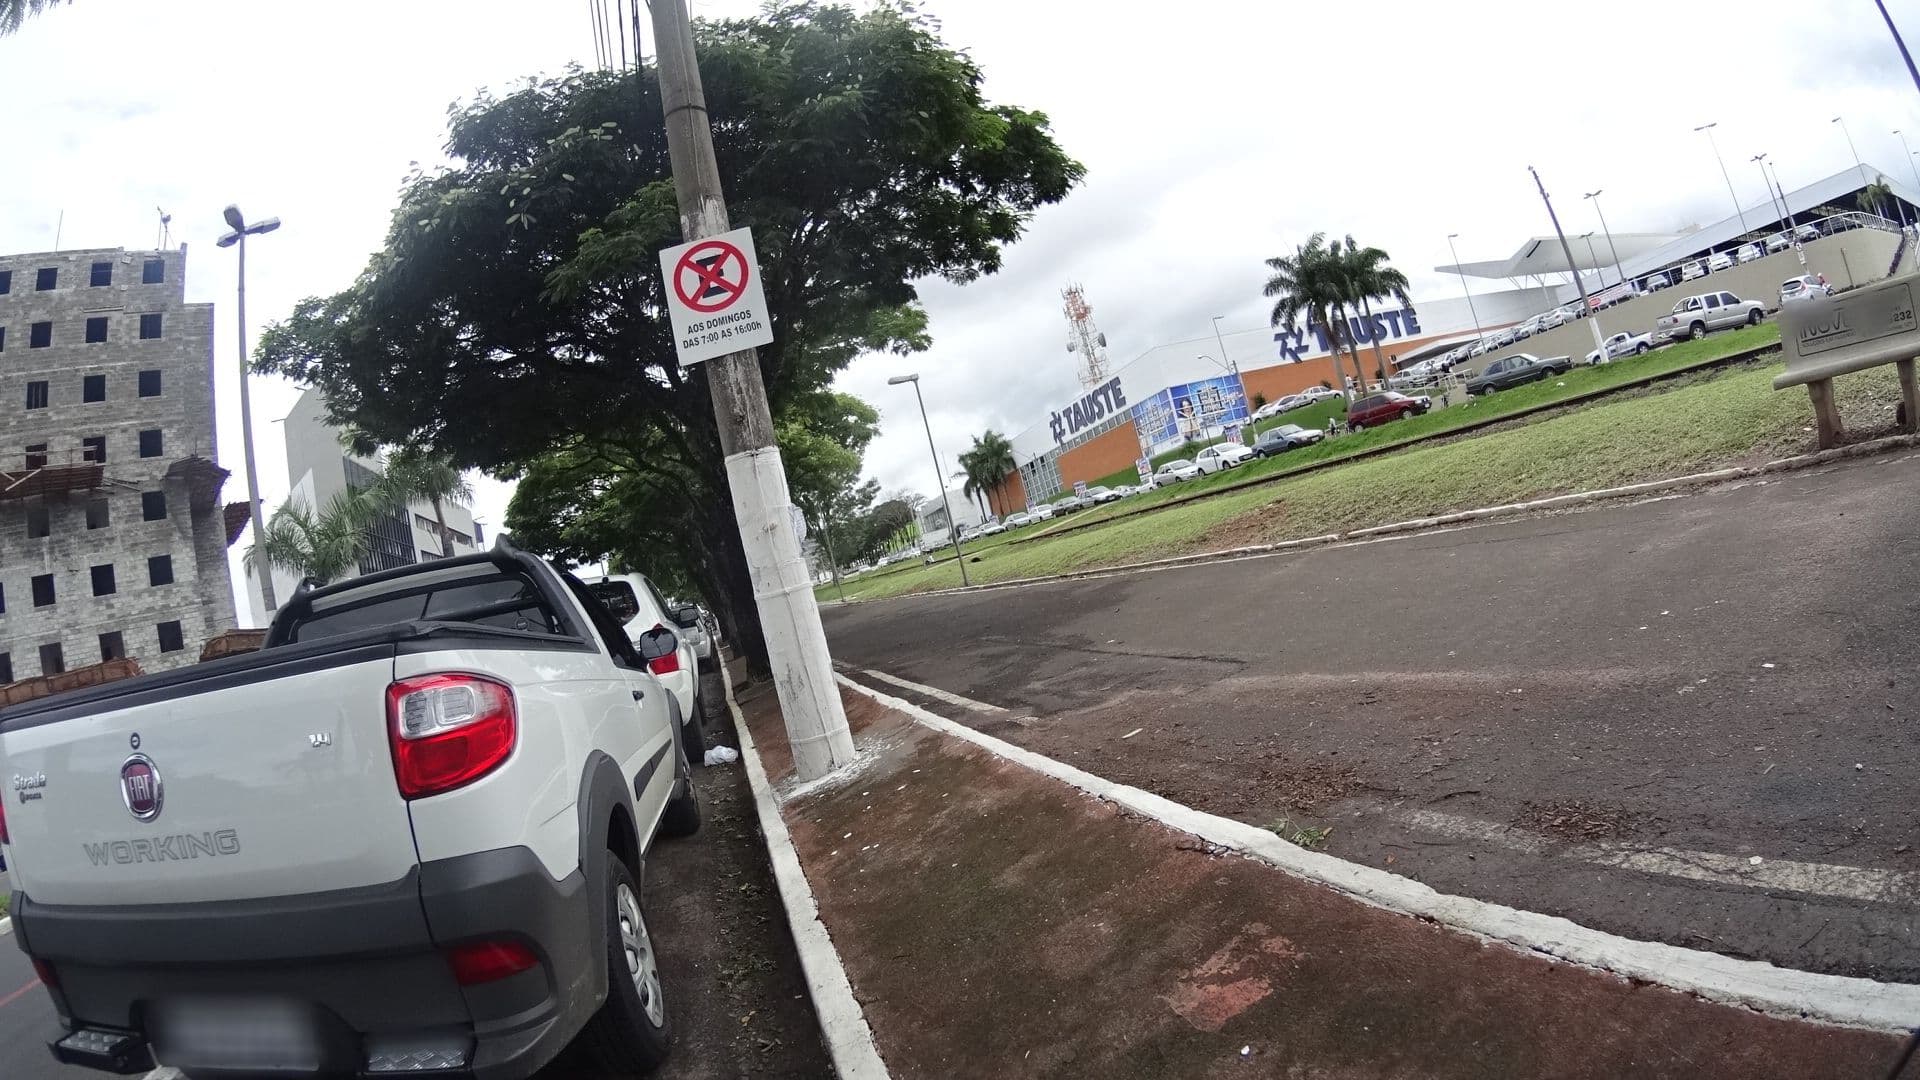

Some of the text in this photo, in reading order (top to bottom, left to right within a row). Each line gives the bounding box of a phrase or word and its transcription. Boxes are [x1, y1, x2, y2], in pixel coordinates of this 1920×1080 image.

[683, 321, 762, 349] DAS 7:00 AS 16:00h
[687, 309, 752, 335] AOS DOMINGOS
[1062, 376, 1127, 434] TAUSTE
[13, 771, 47, 790] Strada
[127, 773, 151, 801] FIAT
[83, 829, 241, 867] WORKING
